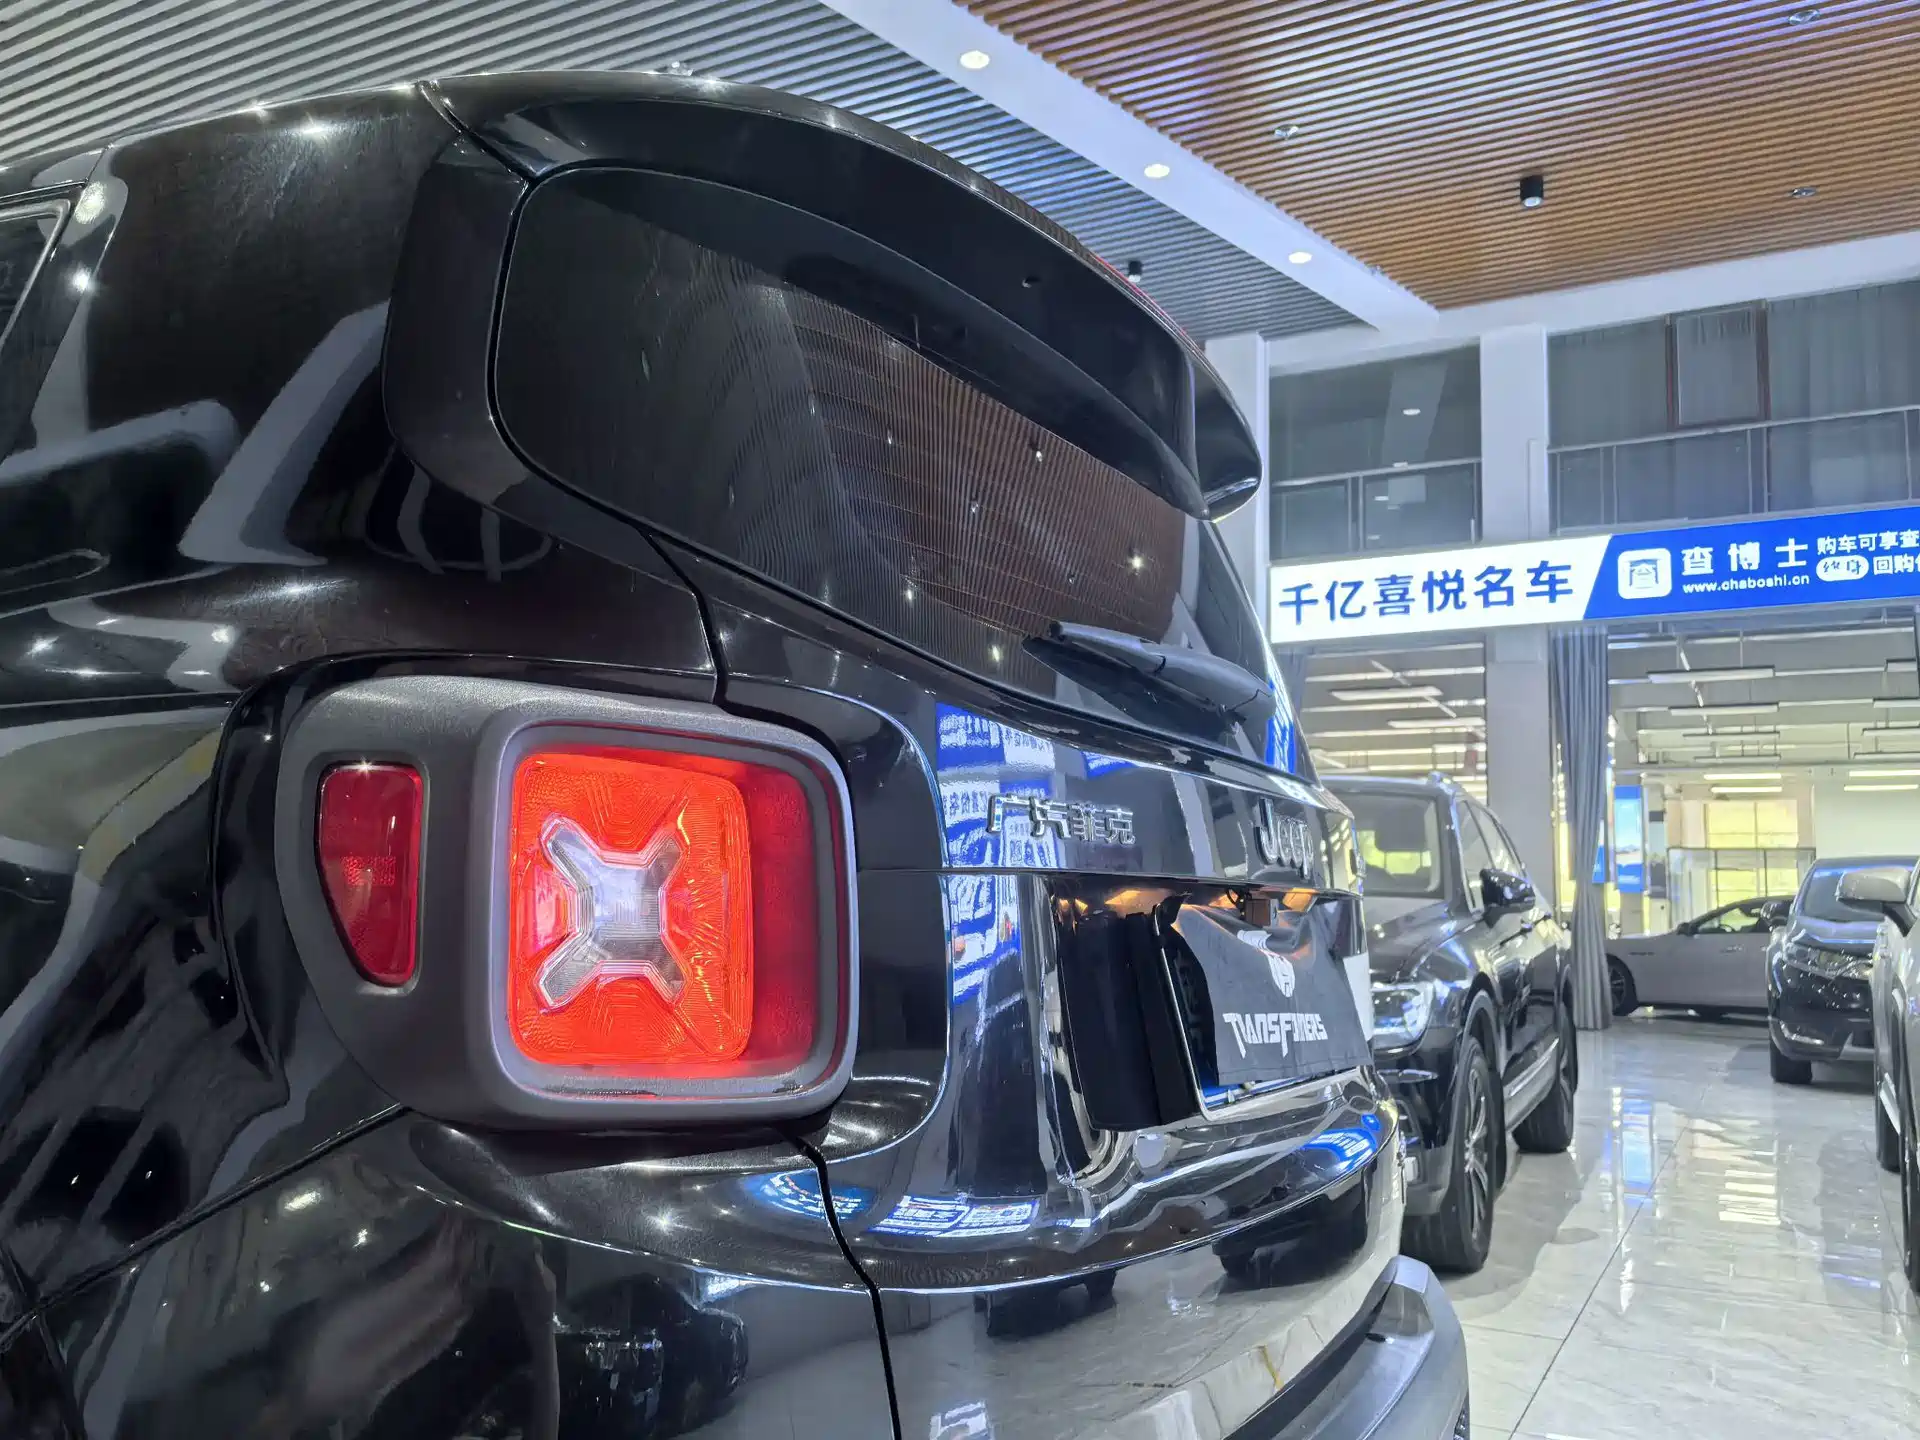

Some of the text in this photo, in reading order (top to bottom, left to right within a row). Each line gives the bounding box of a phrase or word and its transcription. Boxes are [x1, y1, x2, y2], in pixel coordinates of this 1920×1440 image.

[1681, 537, 1808, 576] 查博士
[1279, 560, 1573, 626] 千亿喜悦名车
[985, 794, 1136, 844] 广汽菲克
[1253, 798, 1314, 880] Jeep
